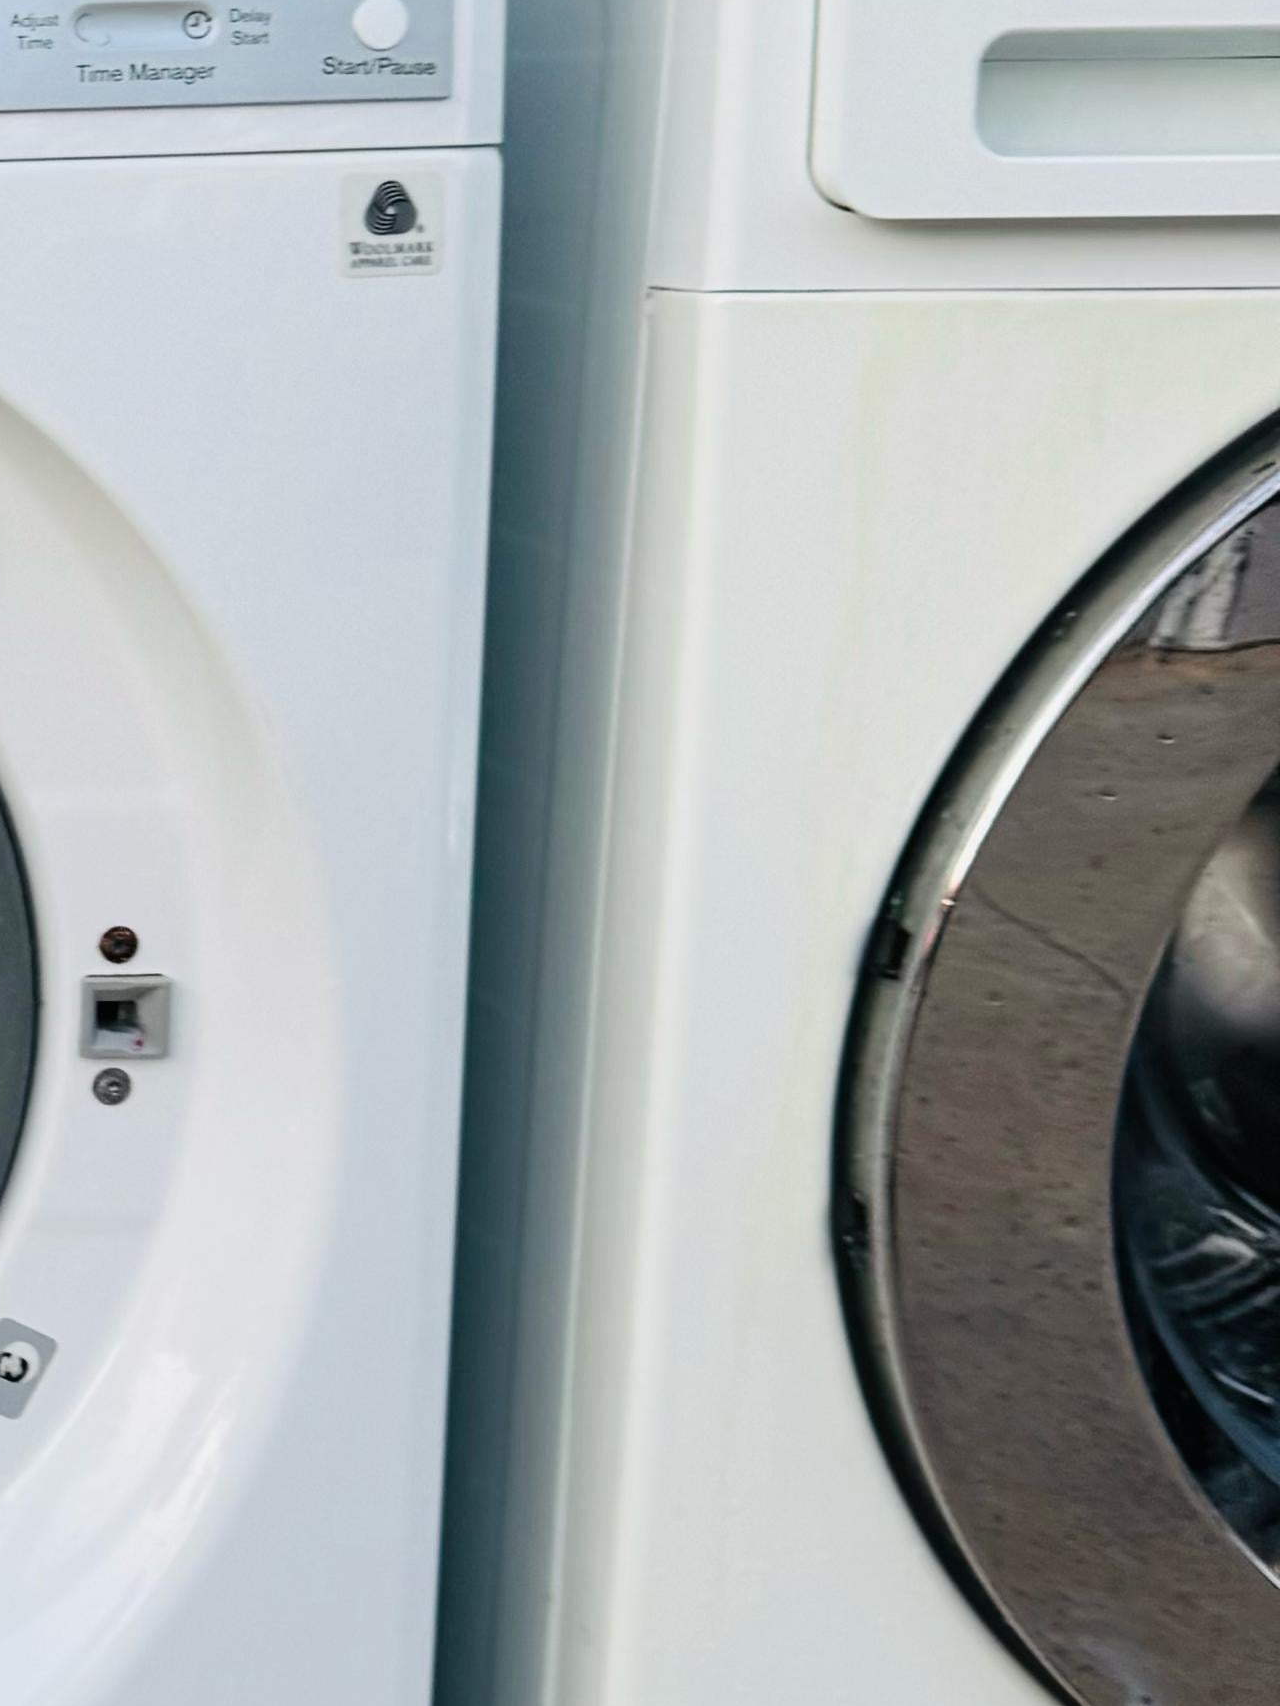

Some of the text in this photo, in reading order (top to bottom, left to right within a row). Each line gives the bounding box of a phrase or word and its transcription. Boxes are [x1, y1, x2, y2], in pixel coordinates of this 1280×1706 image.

[10, 14, 59, 31] Adjust
[228, 8, 272, 26] Delay
[17, 36, 54, 50] Time
[230, 30, 271, 45] Start
[75, 63, 216, 85] Time Manager
[322, 56, 437, 77] Start/Pause
